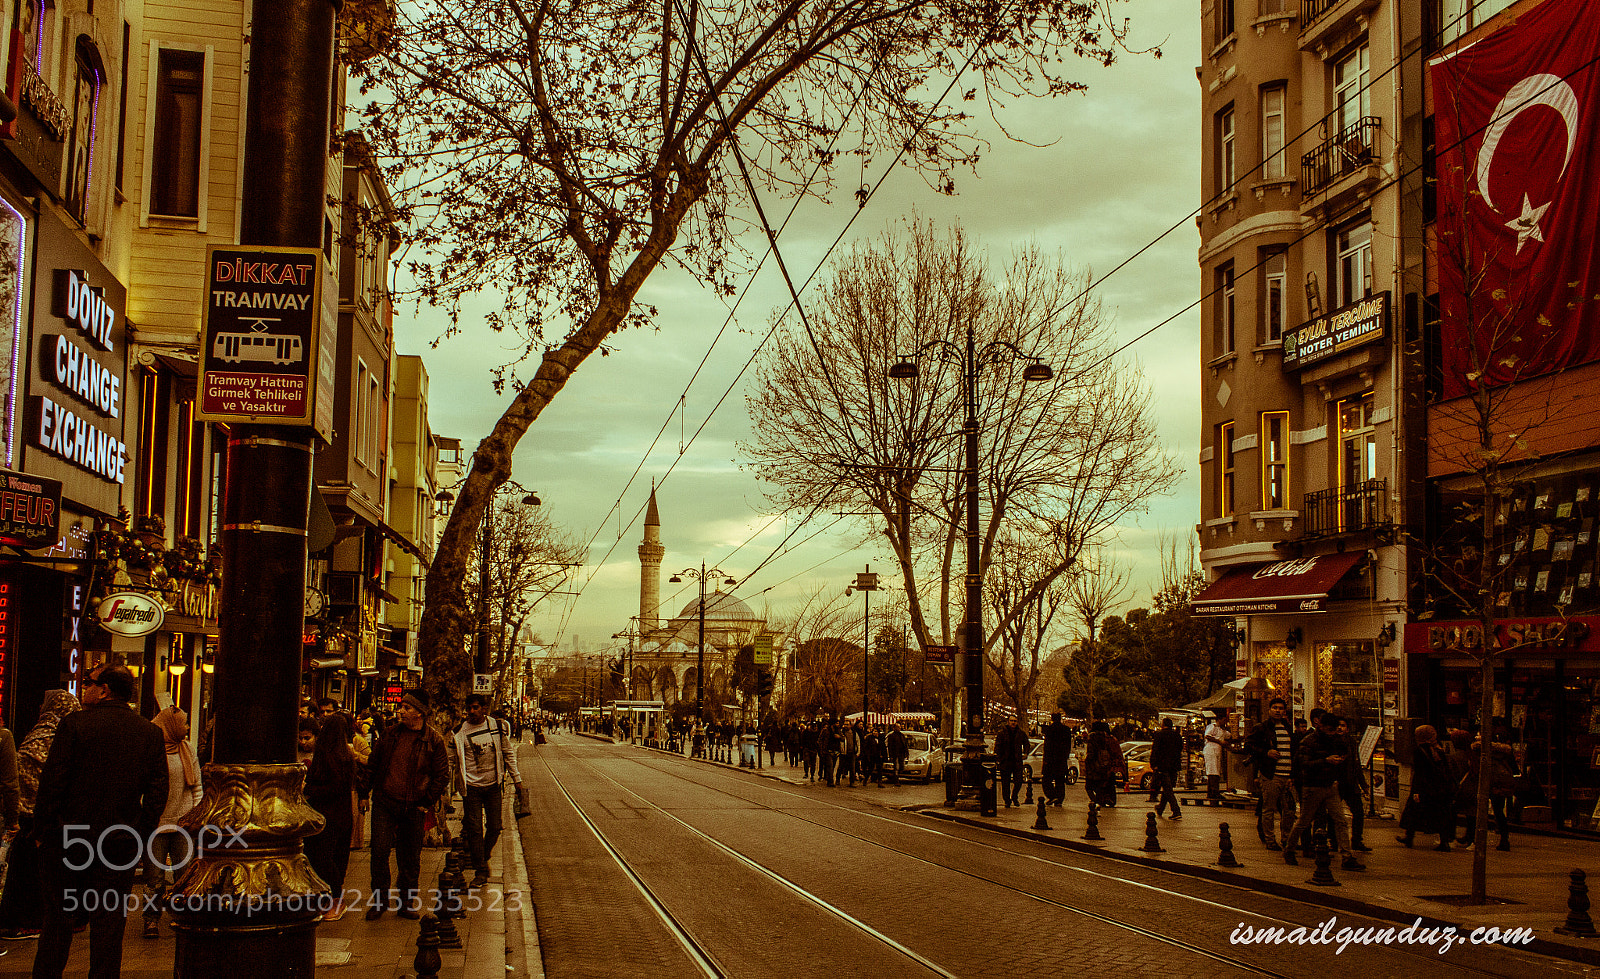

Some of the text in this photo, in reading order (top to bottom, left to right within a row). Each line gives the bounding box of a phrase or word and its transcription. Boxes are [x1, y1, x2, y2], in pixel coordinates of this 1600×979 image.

[215, 257, 312, 285] DİKKAT
[67, 269, 115, 351] DÖVİZ
[213, 290, 311, 310] TRAMVAY
[1298, 318, 1328, 345] EYLÜL
[1330, 297, 1384, 333] TERCÜME
[1299, 337, 1333, 357] NOTER
[1335, 316, 1380, 343] YEMİNLİ
[56, 334, 120, 419] CHANGE
[208, 374, 304, 389] Tramvay Hattına
[208, 387, 302, 401] Girmek Tehlikeli
[222, 401, 287, 412] ve Yasaktır
[40, 396, 126, 484] EXCHANGE
[8, 476, 43, 494] Women
[0, 490, 55, 527] FEUR
[102, 599, 156, 623] Segafredo
[1209, 605, 1236, 613] RESTAURANT
[1506, 621, 1591, 648] SHOP
